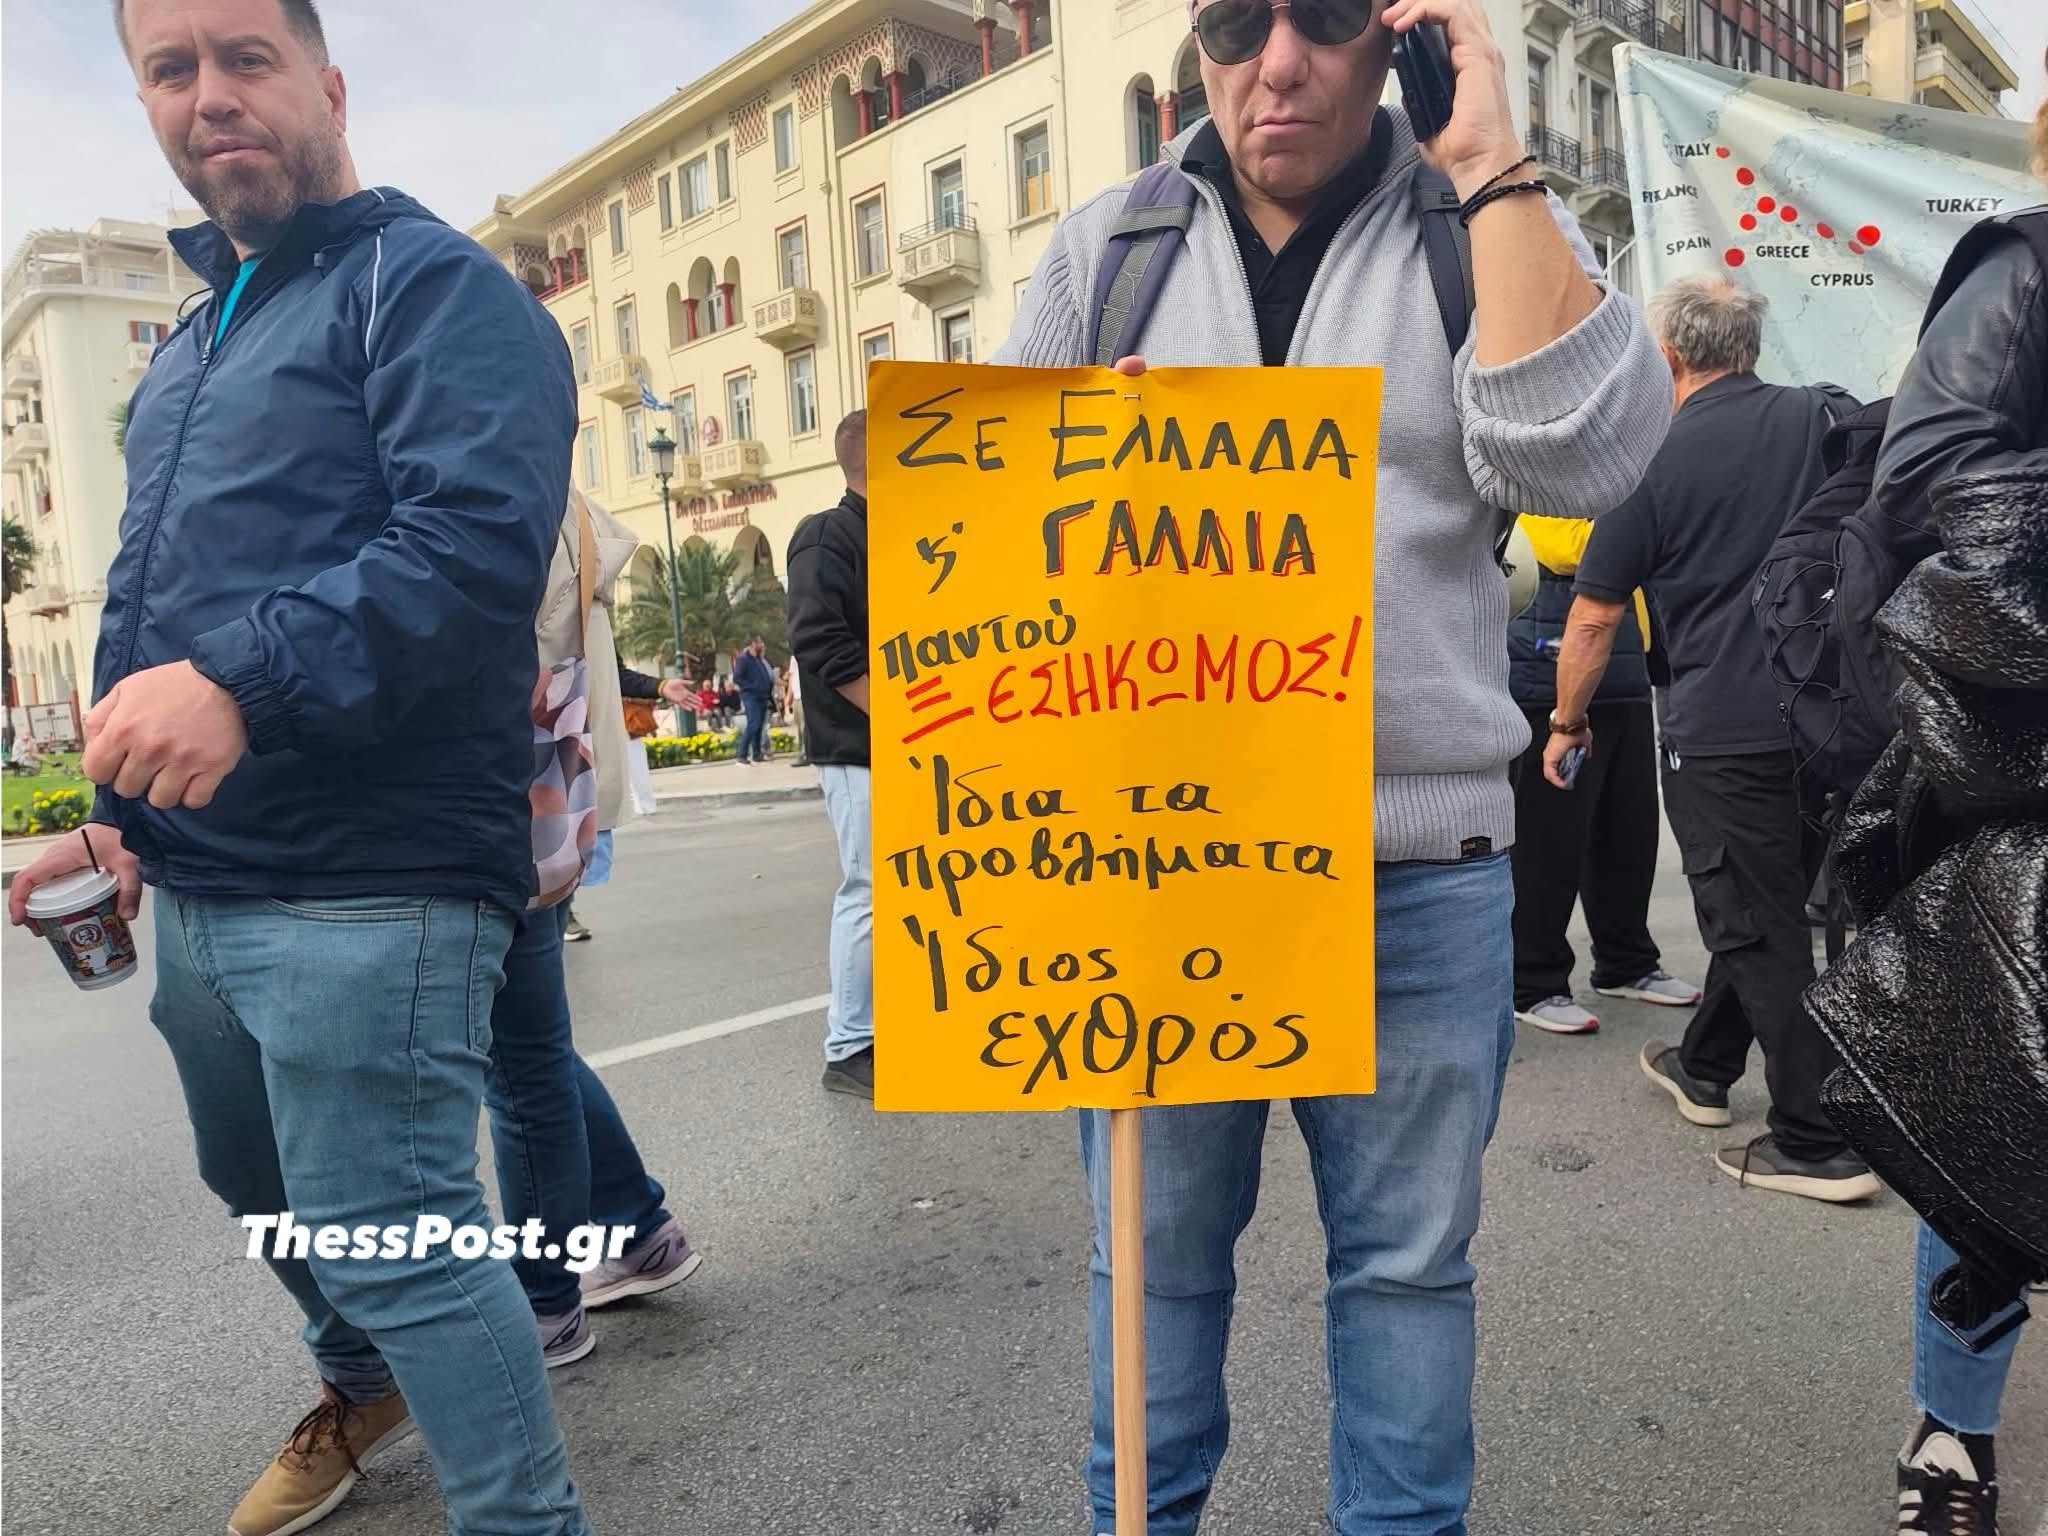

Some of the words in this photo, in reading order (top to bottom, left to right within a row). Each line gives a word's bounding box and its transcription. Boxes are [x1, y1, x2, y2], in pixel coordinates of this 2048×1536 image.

[1674, 143, 1711, 157] ITALY
[1926, 198, 2004, 213] TURKEY
[1665, 236, 1712, 256] SPAIN
[1756, 245, 1810, 258] GREECE
[1810, 273, 1875, 287] CYPRUS
[1042, 499, 1316, 577] ΓΑΛΛΙΑ
[1117, 782, 1223, 814] τα
